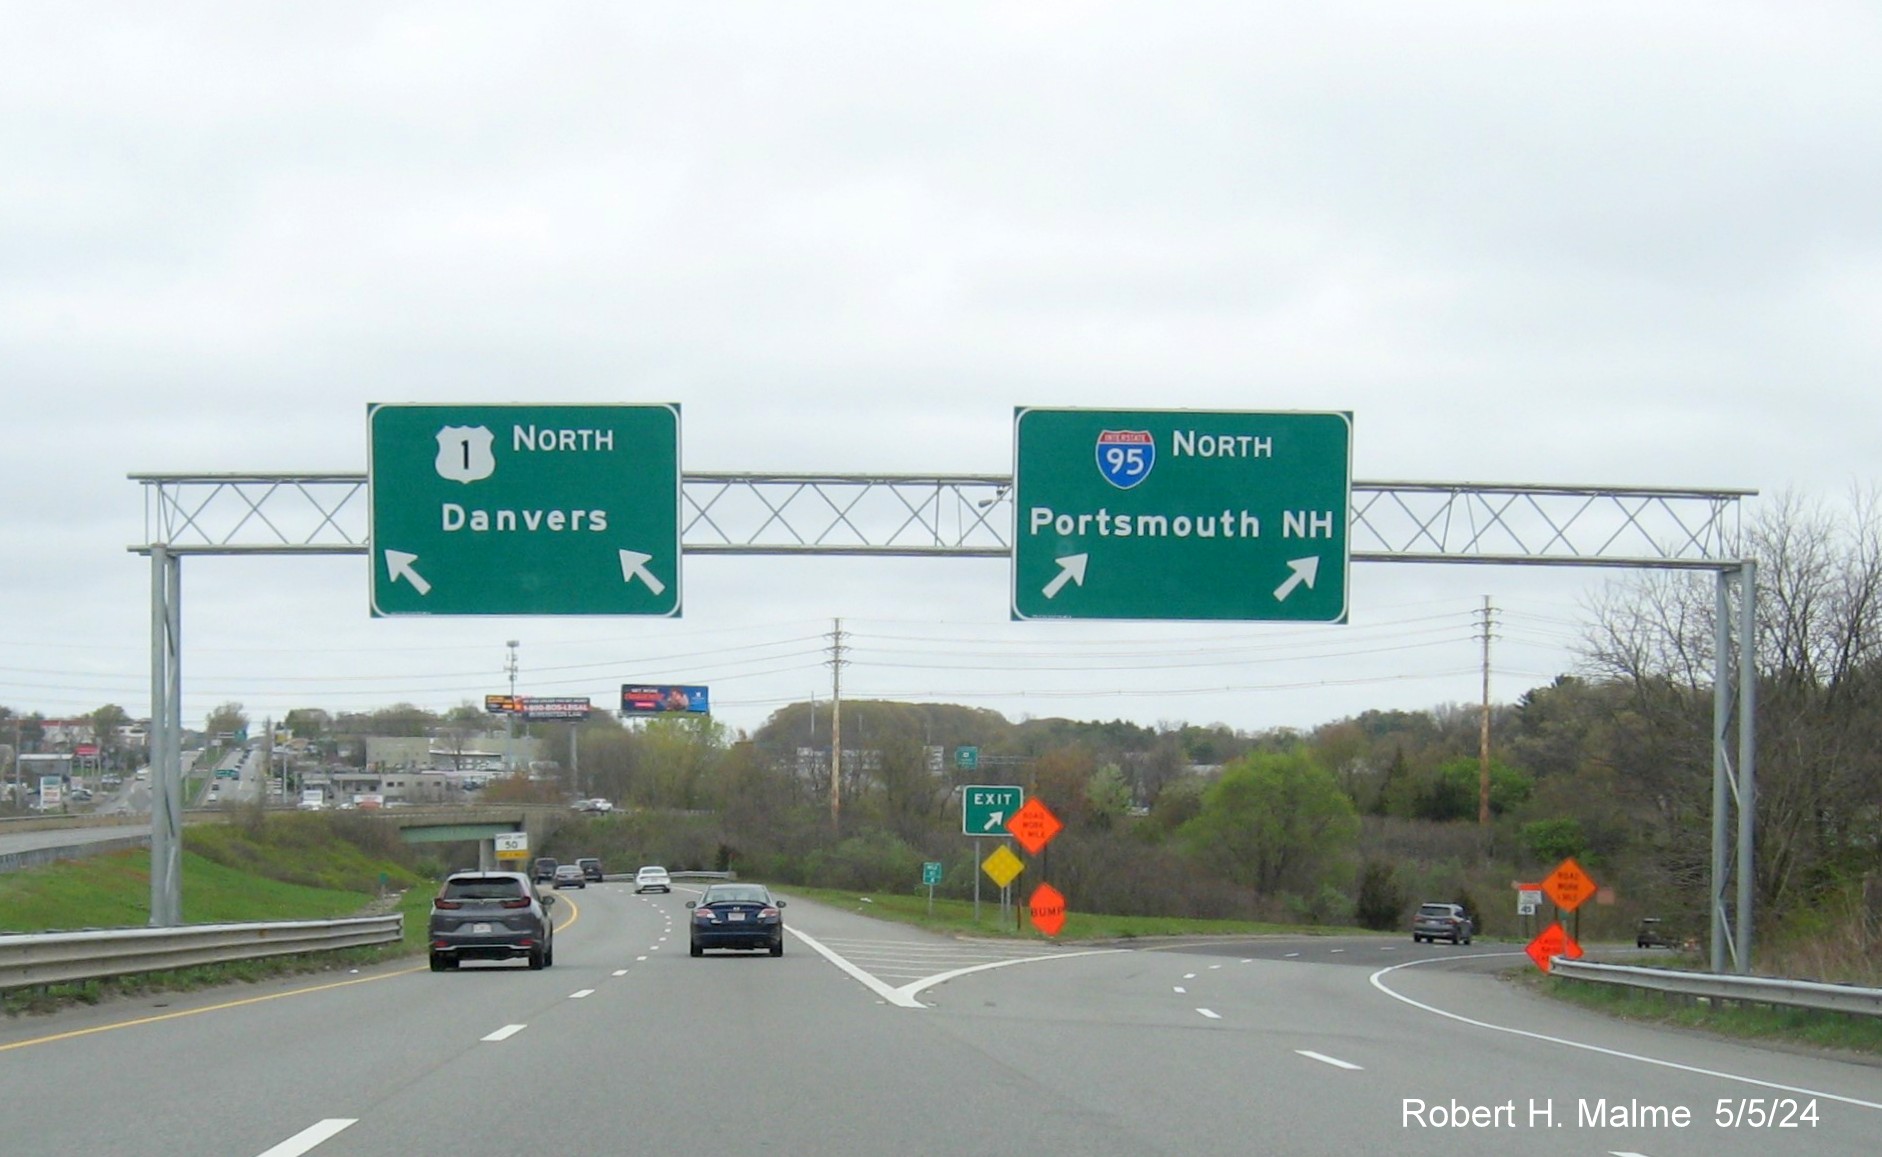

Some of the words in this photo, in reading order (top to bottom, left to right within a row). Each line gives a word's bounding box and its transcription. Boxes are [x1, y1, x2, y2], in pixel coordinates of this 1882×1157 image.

[513, 425, 613, 451] NORTH
[1104, 433, 1147, 442] INTERSTATE
[1173, 430, 1272, 458] NORTH
[460, 439, 470, 470] 1
[1106, 448, 1145, 476] 95
[442, 503, 608, 531] Danvers
[1030, 507, 1260, 538] Portsmouth
[1282, 510, 1333, 538] NH
[974, 793, 1012, 805] EXIT
[1023, 821, 1044, 829] WORK
[504, 840, 518, 849] 50
[1031, 907, 1064, 917] BUMP
